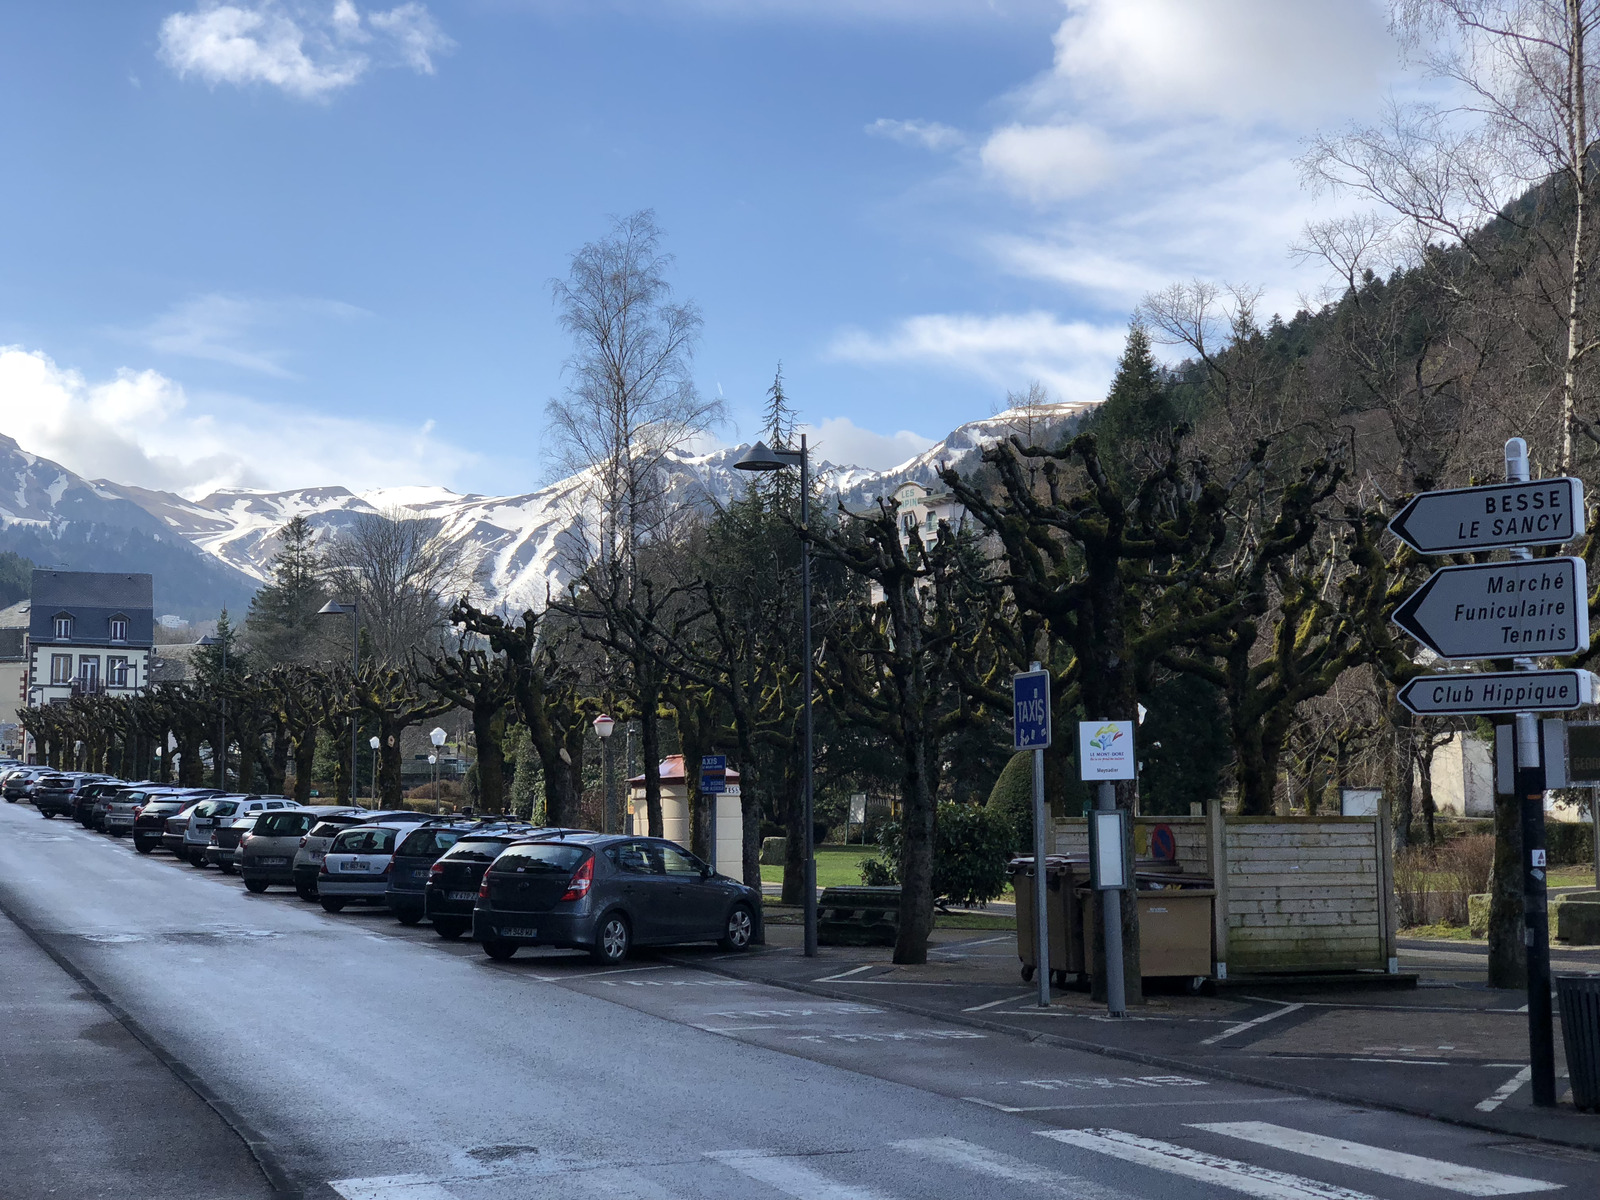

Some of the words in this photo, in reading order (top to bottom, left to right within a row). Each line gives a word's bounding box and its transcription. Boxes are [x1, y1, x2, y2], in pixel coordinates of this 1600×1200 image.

[902, 488, 914, 498] LES
[1486, 491, 1560, 514] BESSE
[1458, 521, 1481, 539] LE
[1492, 513, 1563, 535] SANCY
[1487, 571, 1564, 594] Marché
[1454, 602, 1566, 622] Funiculaire
[1502, 624, 1566, 644] Tennis
[1432, 684, 1474, 704] Club
[1483, 682, 1569, 706] Hippique
[1017, 698, 1045, 724] TAXIS
[702, 757, 718, 765] AXIS
[704, 1006, 888, 1018] TAXIS
[785, 1030, 988, 1043] TAXIS
